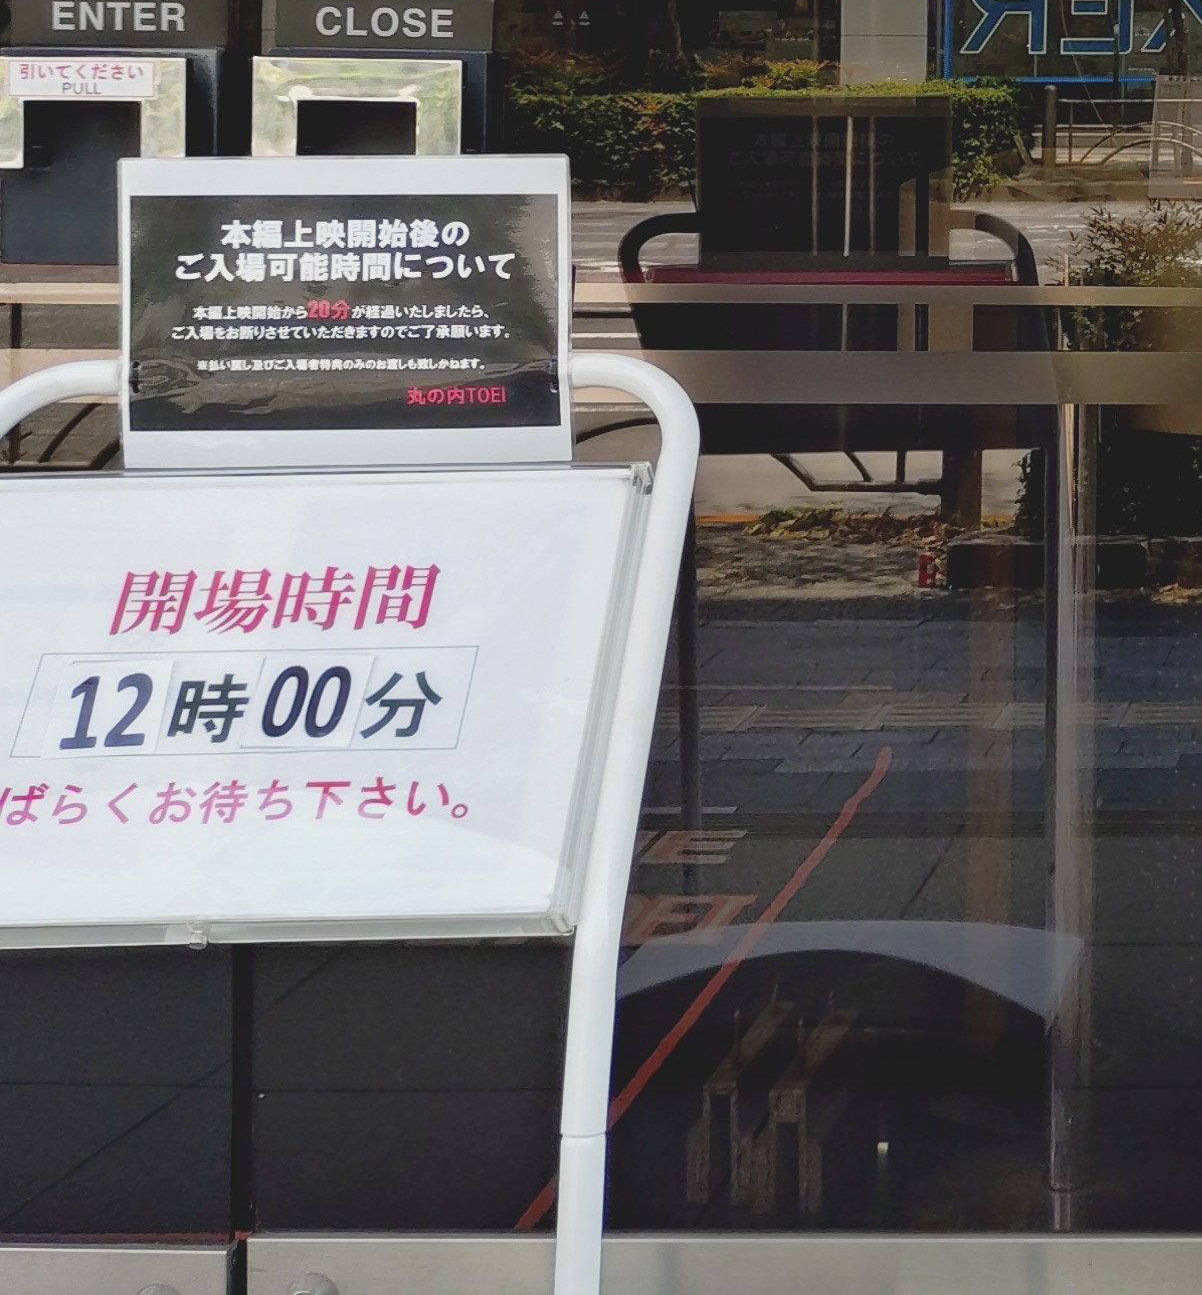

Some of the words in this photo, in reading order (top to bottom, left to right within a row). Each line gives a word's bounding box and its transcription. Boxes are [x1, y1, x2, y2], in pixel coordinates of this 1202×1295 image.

[51, 1, 187, 32] ENTER
[315, 6, 455, 39] CLOSE
[19, 62, 145, 81] 引いてください
[61, 82, 102, 96] PULL
[220, 218, 470, 249] 本編上映開始後の
[174, 253, 516, 282] ご入場可能時間について
[407, 386, 507, 405] 丸の内TOEI
[109, 563, 441, 635] 開場時間
[59, 664, 443, 750] 12時00分
